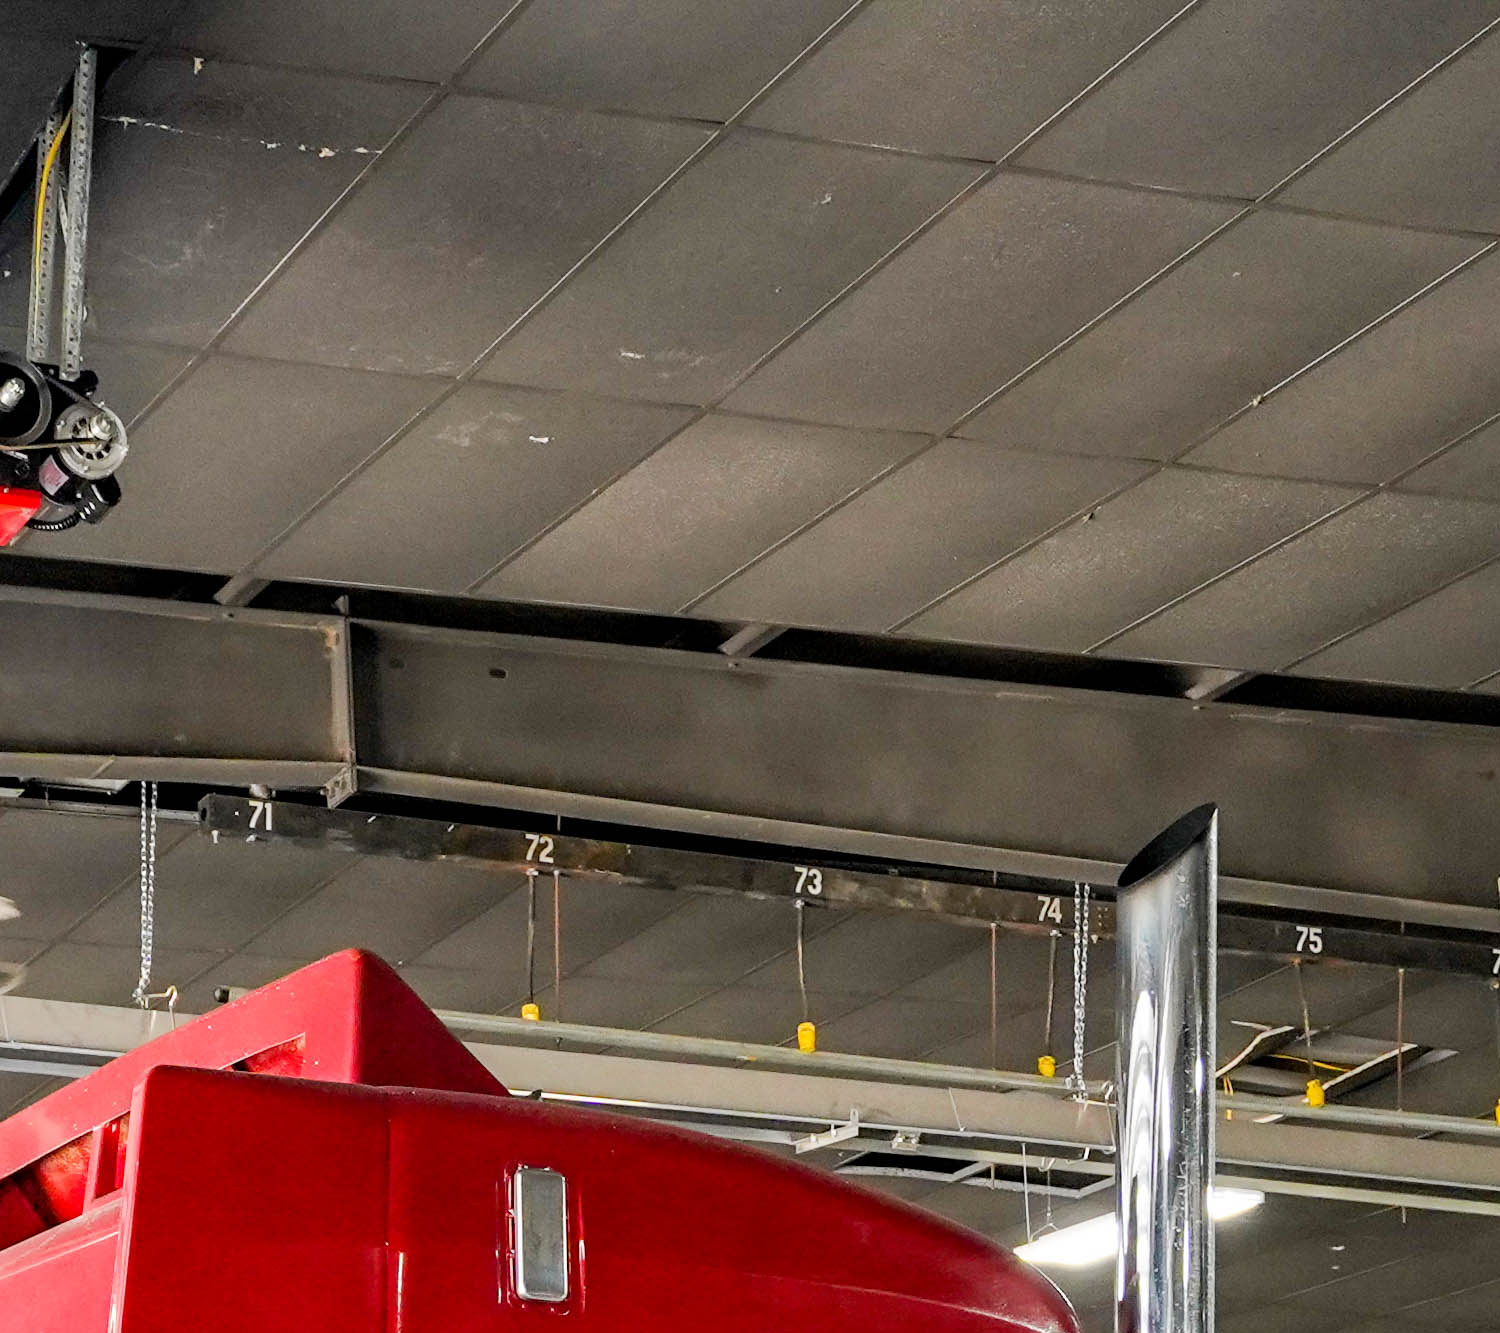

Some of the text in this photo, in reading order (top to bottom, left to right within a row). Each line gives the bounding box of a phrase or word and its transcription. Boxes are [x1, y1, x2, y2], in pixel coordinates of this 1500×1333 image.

[248, 800, 273, 831] 71
[525, 834, 554, 864] 72
[794, 866, 823, 895] 73
[1037, 895, 1063, 924] 74
[1295, 925, 1323, 954] 75
